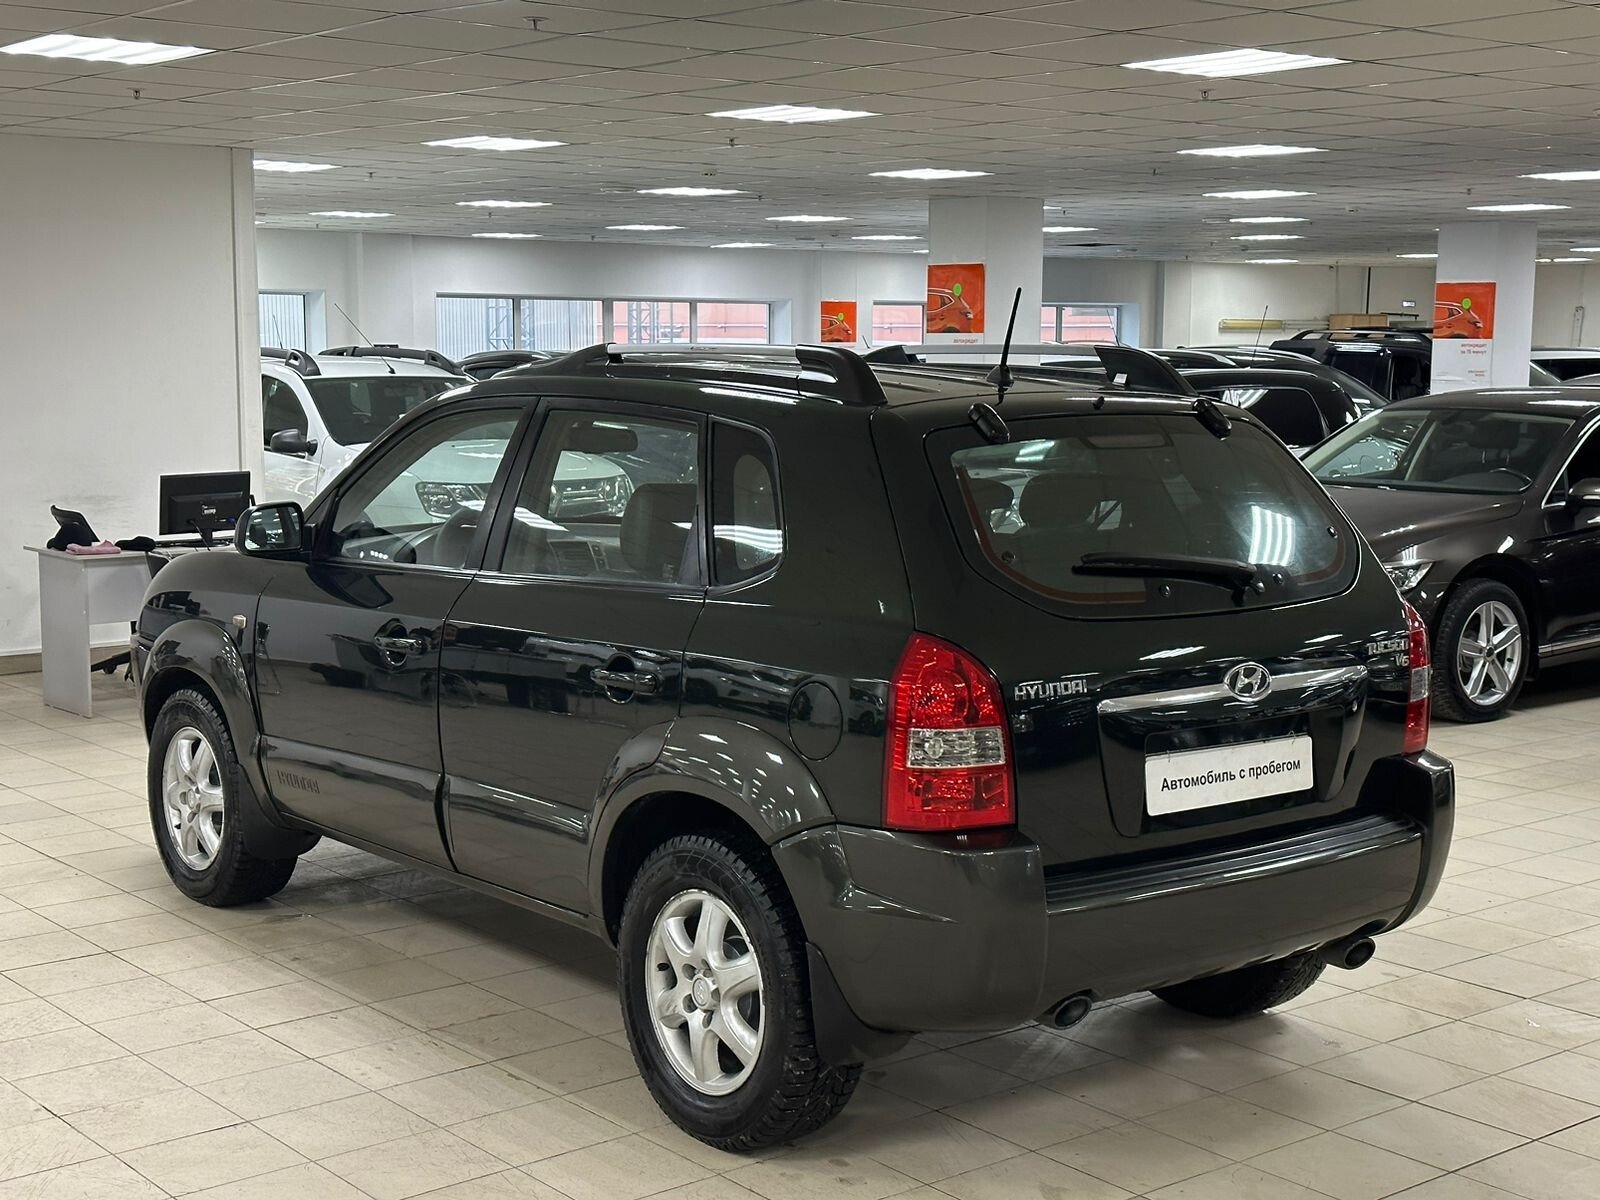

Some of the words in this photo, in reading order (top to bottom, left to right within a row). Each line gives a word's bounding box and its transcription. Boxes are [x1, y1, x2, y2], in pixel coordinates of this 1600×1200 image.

[1393, 653, 1410, 666] V6
[1014, 680, 1087, 701] HYUNDAI
[277, 769, 320, 794] HYUNDAI
[1161, 770, 1236, 791] Автомобиль
[1239, 768, 1246, 778] с
[1249, 759, 1301, 780] пробегом
